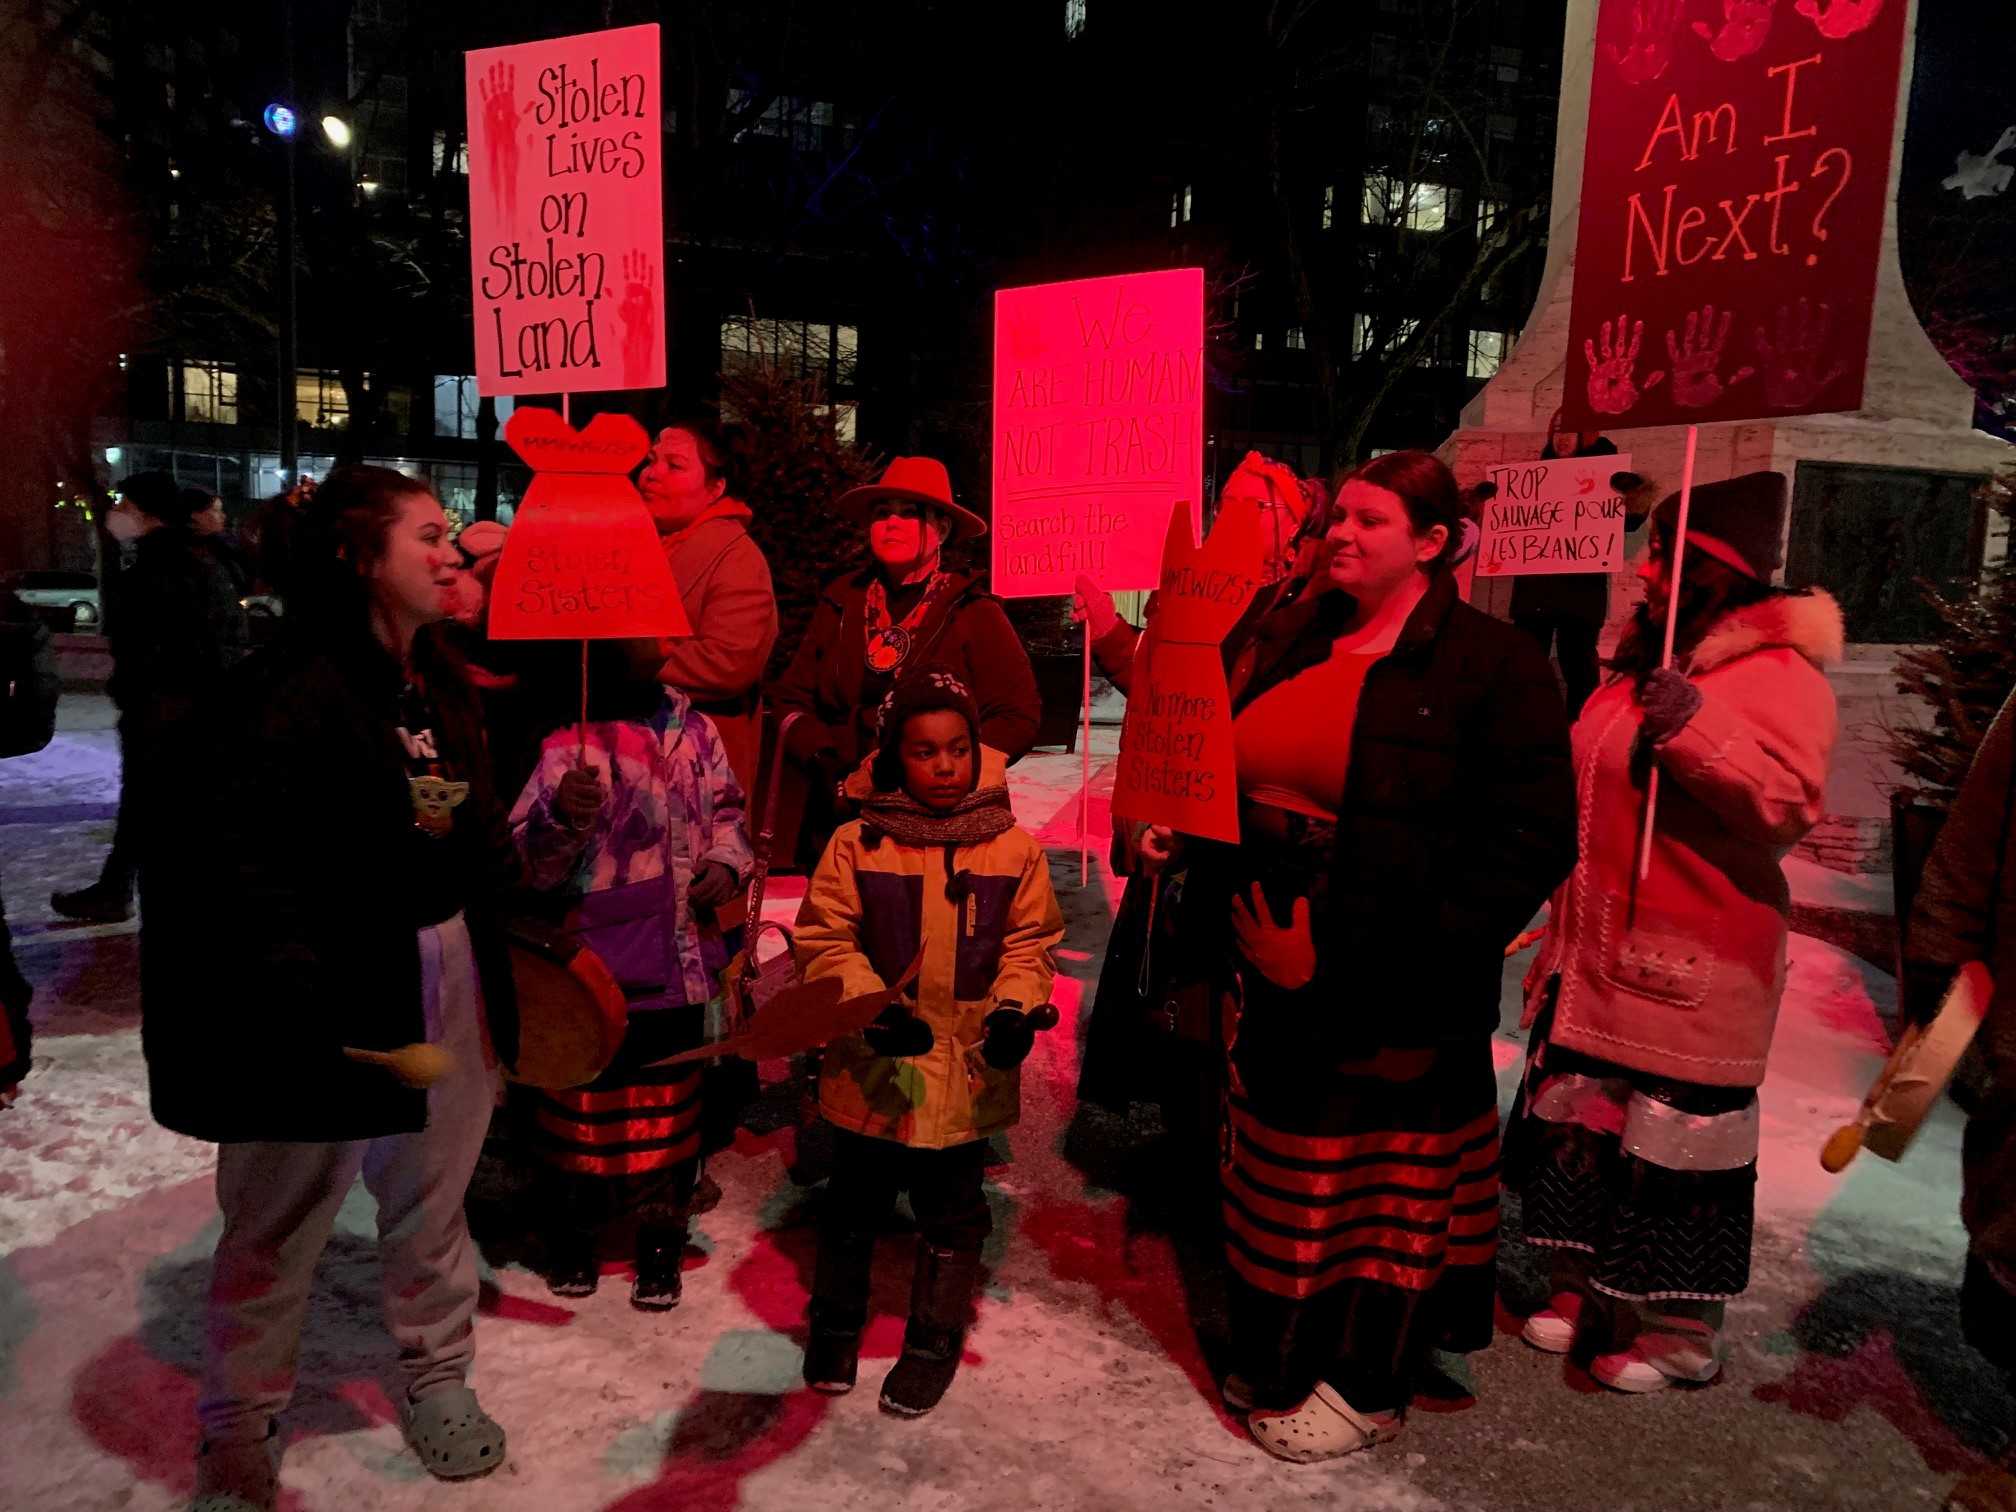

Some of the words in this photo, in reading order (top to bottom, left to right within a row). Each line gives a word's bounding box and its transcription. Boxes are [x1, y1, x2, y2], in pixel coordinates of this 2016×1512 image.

[535, 58, 645, 128] Stolen
[1634, 93, 1737, 171] Am
[1764, 53, 1822, 146] I
[548, 131, 645, 179] Lives
[540, 191, 588, 237] on
[1621, 148, 1853, 282] Next?
[481, 238, 604, 300] Stolen
[493, 300, 601, 378] Land
[1072, 284, 1154, 350] We
[1007, 362, 1070, 408] ARE
[1083, 347, 1204, 407] HUMAN
[1002, 421, 1064, 481] NOT
[1078, 412, 1196, 476] TRASH
[1490, 466, 1548, 500] TROP
[1084, 503, 1129, 534] the
[1490, 501, 1564, 531] SAUVAGE
[527, 544, 632, 574] Stolen
[1487, 536, 1517, 566] LES
[516, 576, 664, 614] Sisters
[1134, 721, 1204, 760] Stolen
[1129, 756, 1215, 802] Sisters
